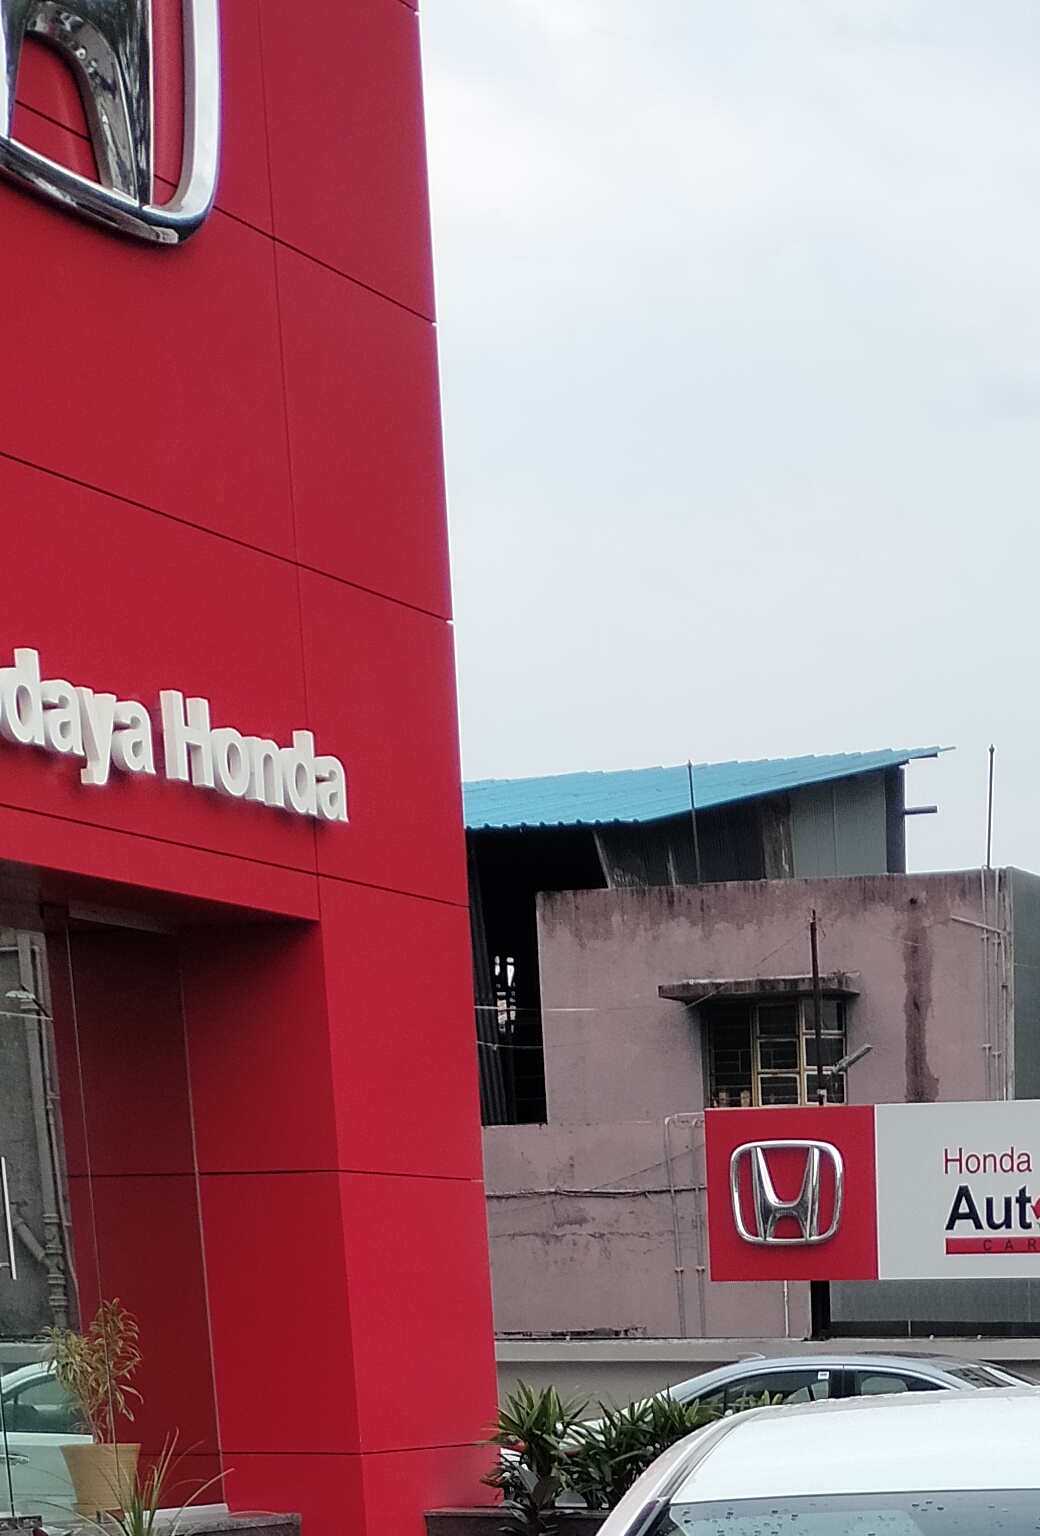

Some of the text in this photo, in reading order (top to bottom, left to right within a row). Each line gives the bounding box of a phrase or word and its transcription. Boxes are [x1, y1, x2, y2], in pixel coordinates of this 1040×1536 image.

[159, 689, 349, 823] Honda
[944, 1147, 1032, 1174] Honda
[983, 1238, 1037, 1251] CAR
